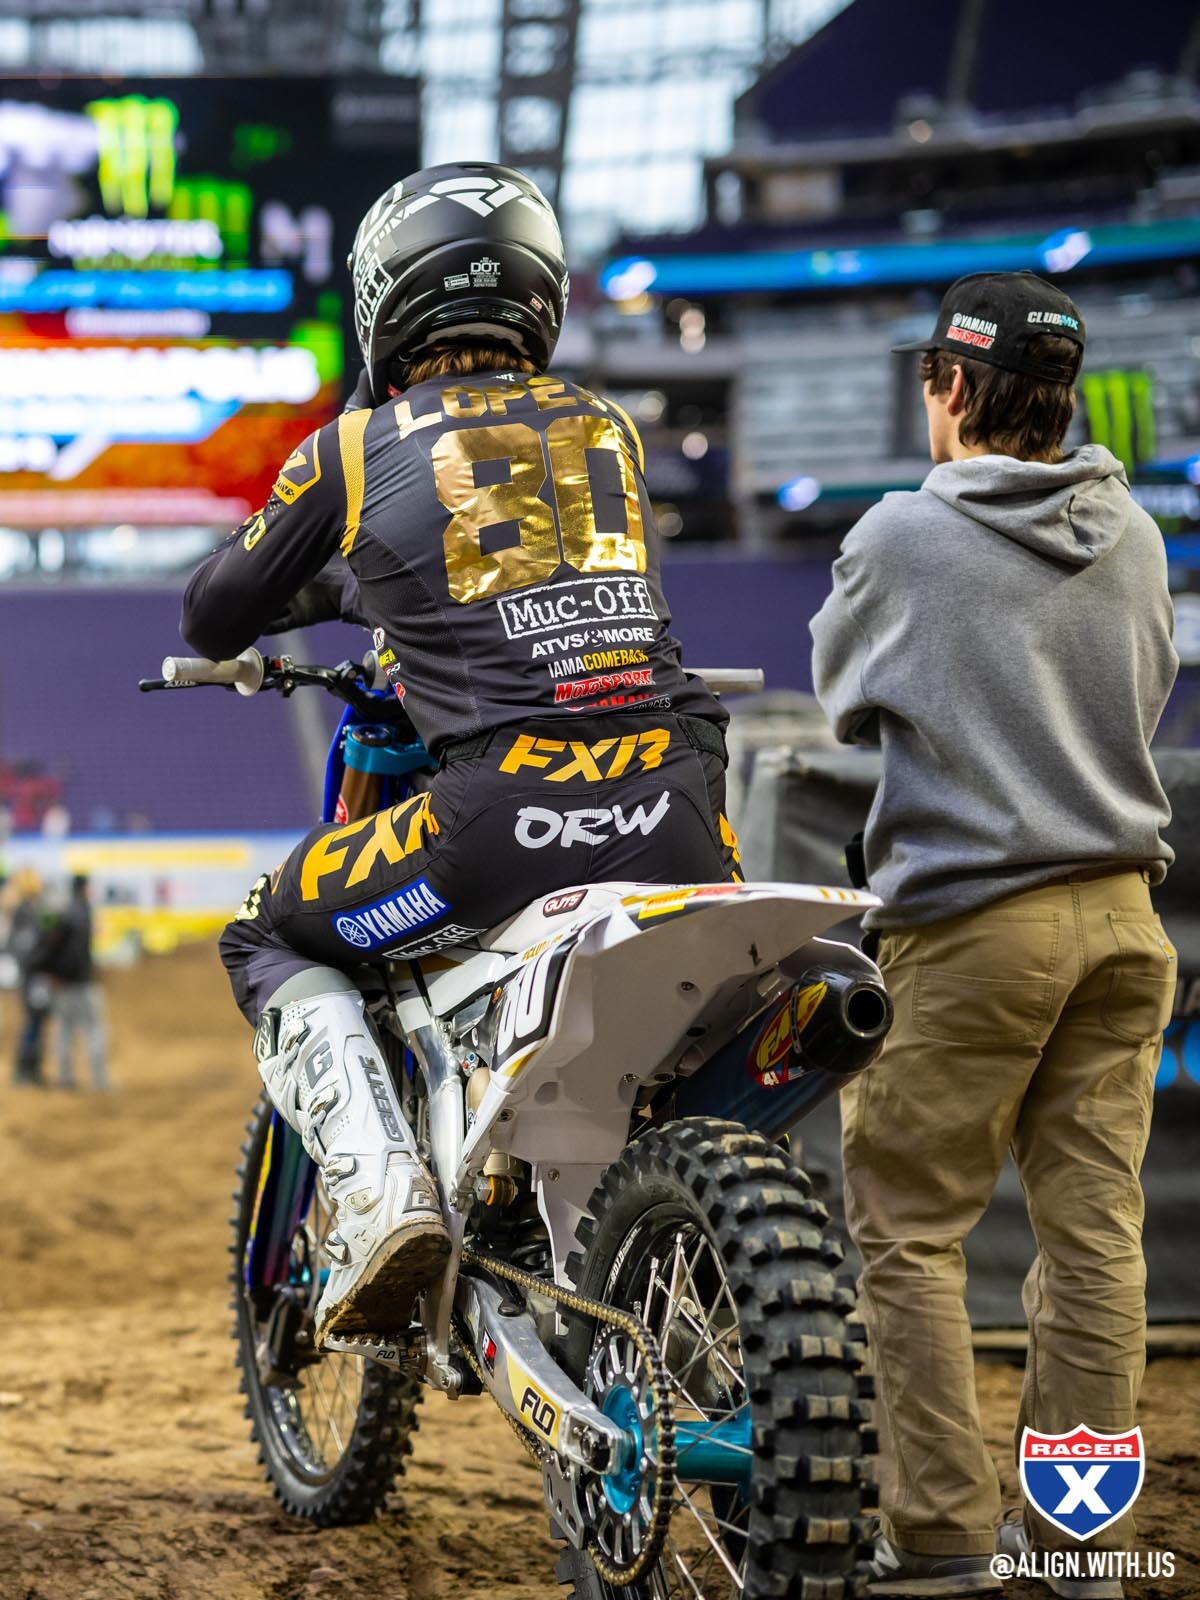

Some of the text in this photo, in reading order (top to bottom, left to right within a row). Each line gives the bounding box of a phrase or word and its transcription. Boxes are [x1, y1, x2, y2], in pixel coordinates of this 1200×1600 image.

[470, 262, 500, 273] DOT
[960, 313, 998, 337] YAMAHA
[1027, 311, 1079, 331] CLUBMX
[430, 415, 649, 604] 80
[506, 583, 652, 633] Muc-Off
[531, 627, 656, 659] ATVS&MORE
[548, 648, 649, 679] IAMACOMEBACK
[514, 790, 671, 849] ORW
[356, 882, 446, 940] YAMAHA
[544, 891, 582, 913] GUTS
[375, 1350, 396, 1360] FLO
[520, 1386, 556, 1437] FLO
